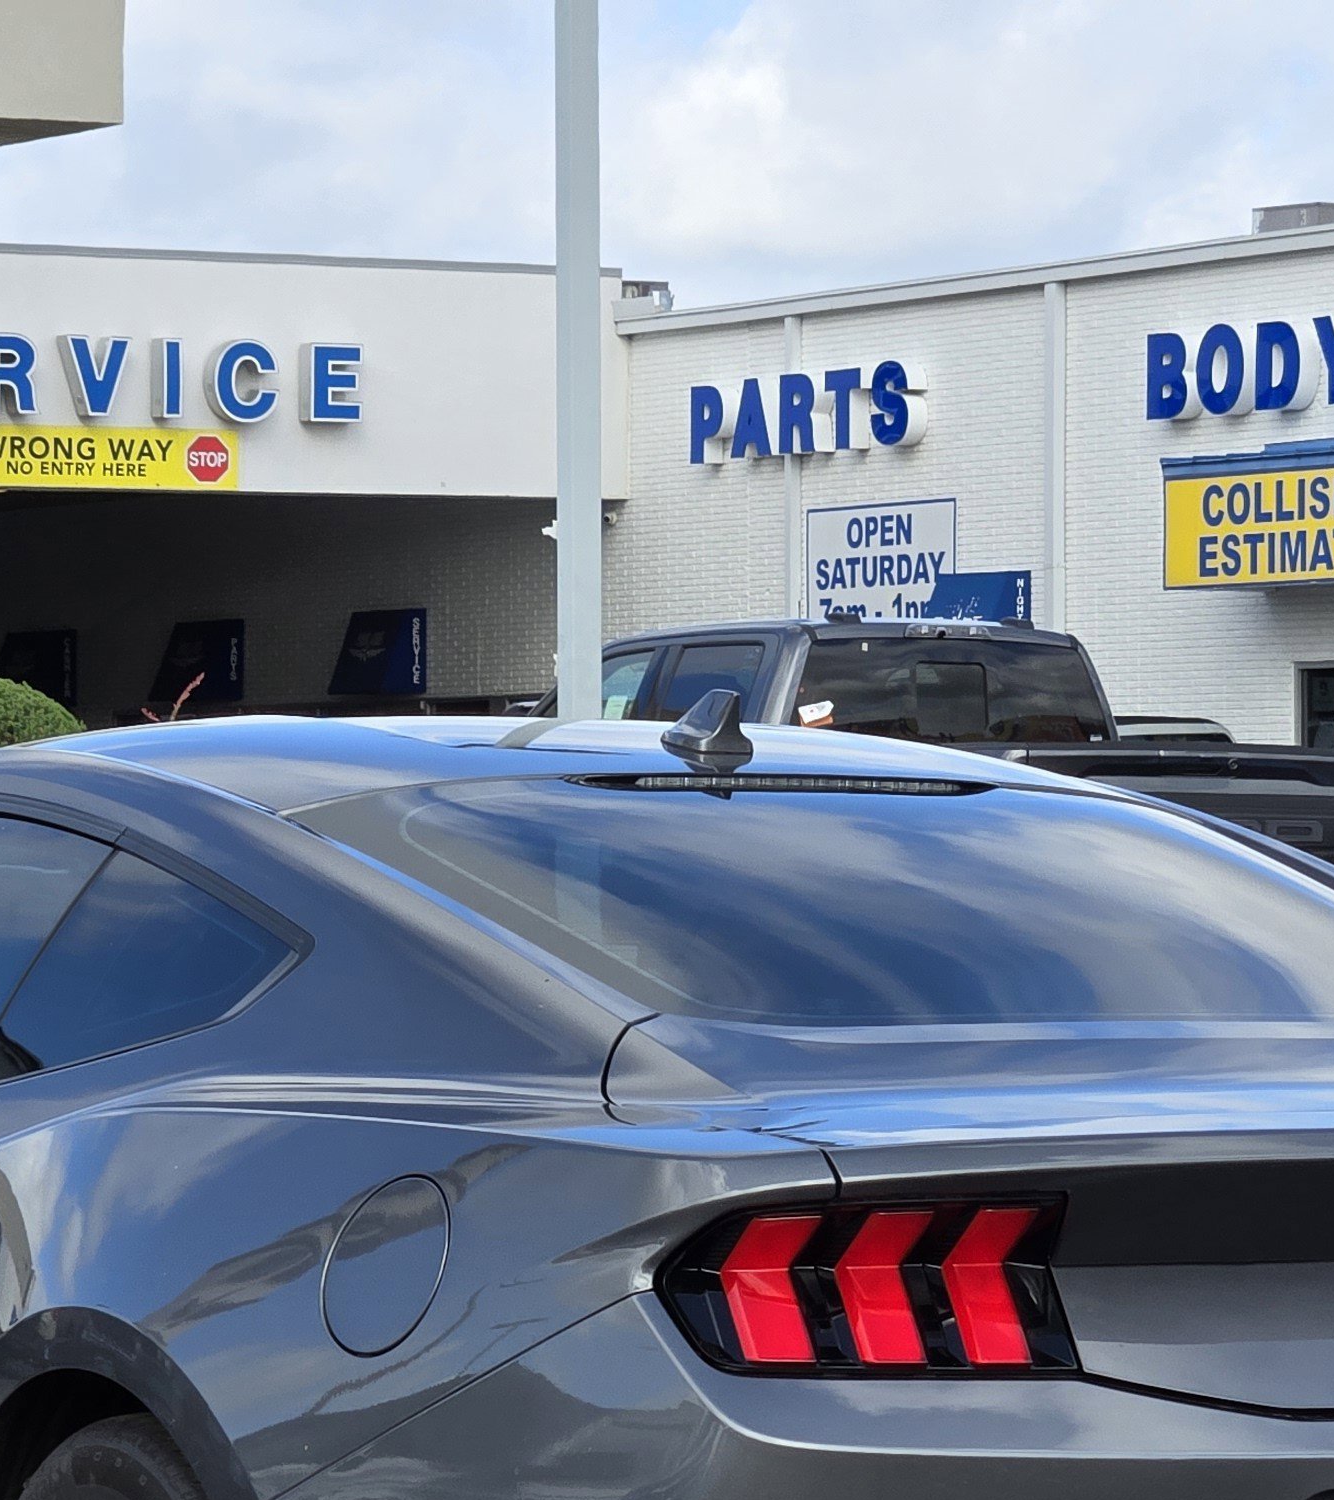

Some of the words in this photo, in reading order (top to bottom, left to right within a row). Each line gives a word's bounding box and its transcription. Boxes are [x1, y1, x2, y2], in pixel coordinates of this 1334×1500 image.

[689, 360, 910, 465] PARTS
[6, 460, 34, 475] NO
[40, 461, 97, 477] ENTRY
[102, 463, 147, 477] HERE
[107, 438, 174, 462] WAY
[187, 450, 227, 467] STOP
[846, 513, 913, 548] OPEN
[816, 551, 946, 591] SATURDAY
[229, 638, 238, 681] PARTS
[412, 617, 421, 684] SERVICE
